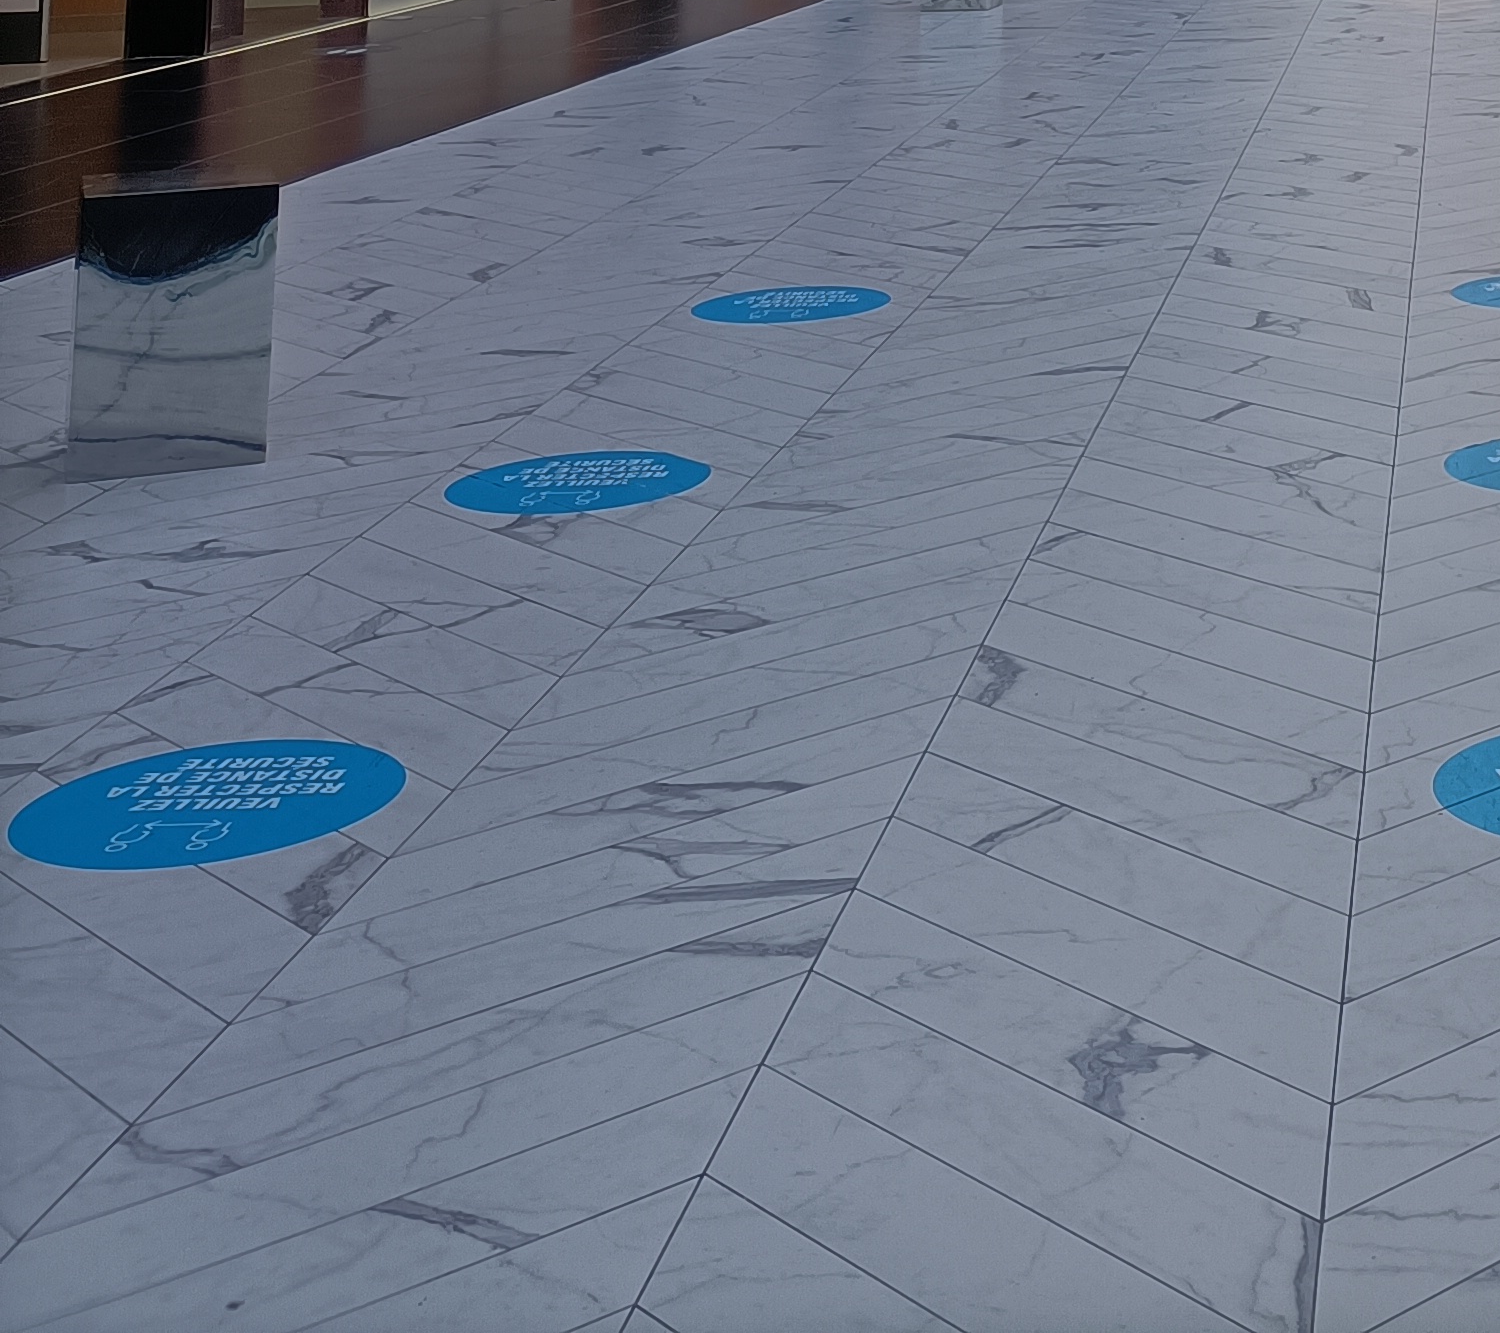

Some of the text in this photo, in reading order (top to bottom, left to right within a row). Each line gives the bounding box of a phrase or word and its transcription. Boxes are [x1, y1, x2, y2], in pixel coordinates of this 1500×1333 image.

[556, 464, 667, 473] DISTANCE
[503, 470, 670, 482] RESPECTER LA
[523, 479, 628, 488] VEUILLEZ
[132, 769, 348, 784] DISTANCE DE
[106, 782, 346, 798] RESPECTER LA
[127, 796, 282, 812] VEUILLEZ
